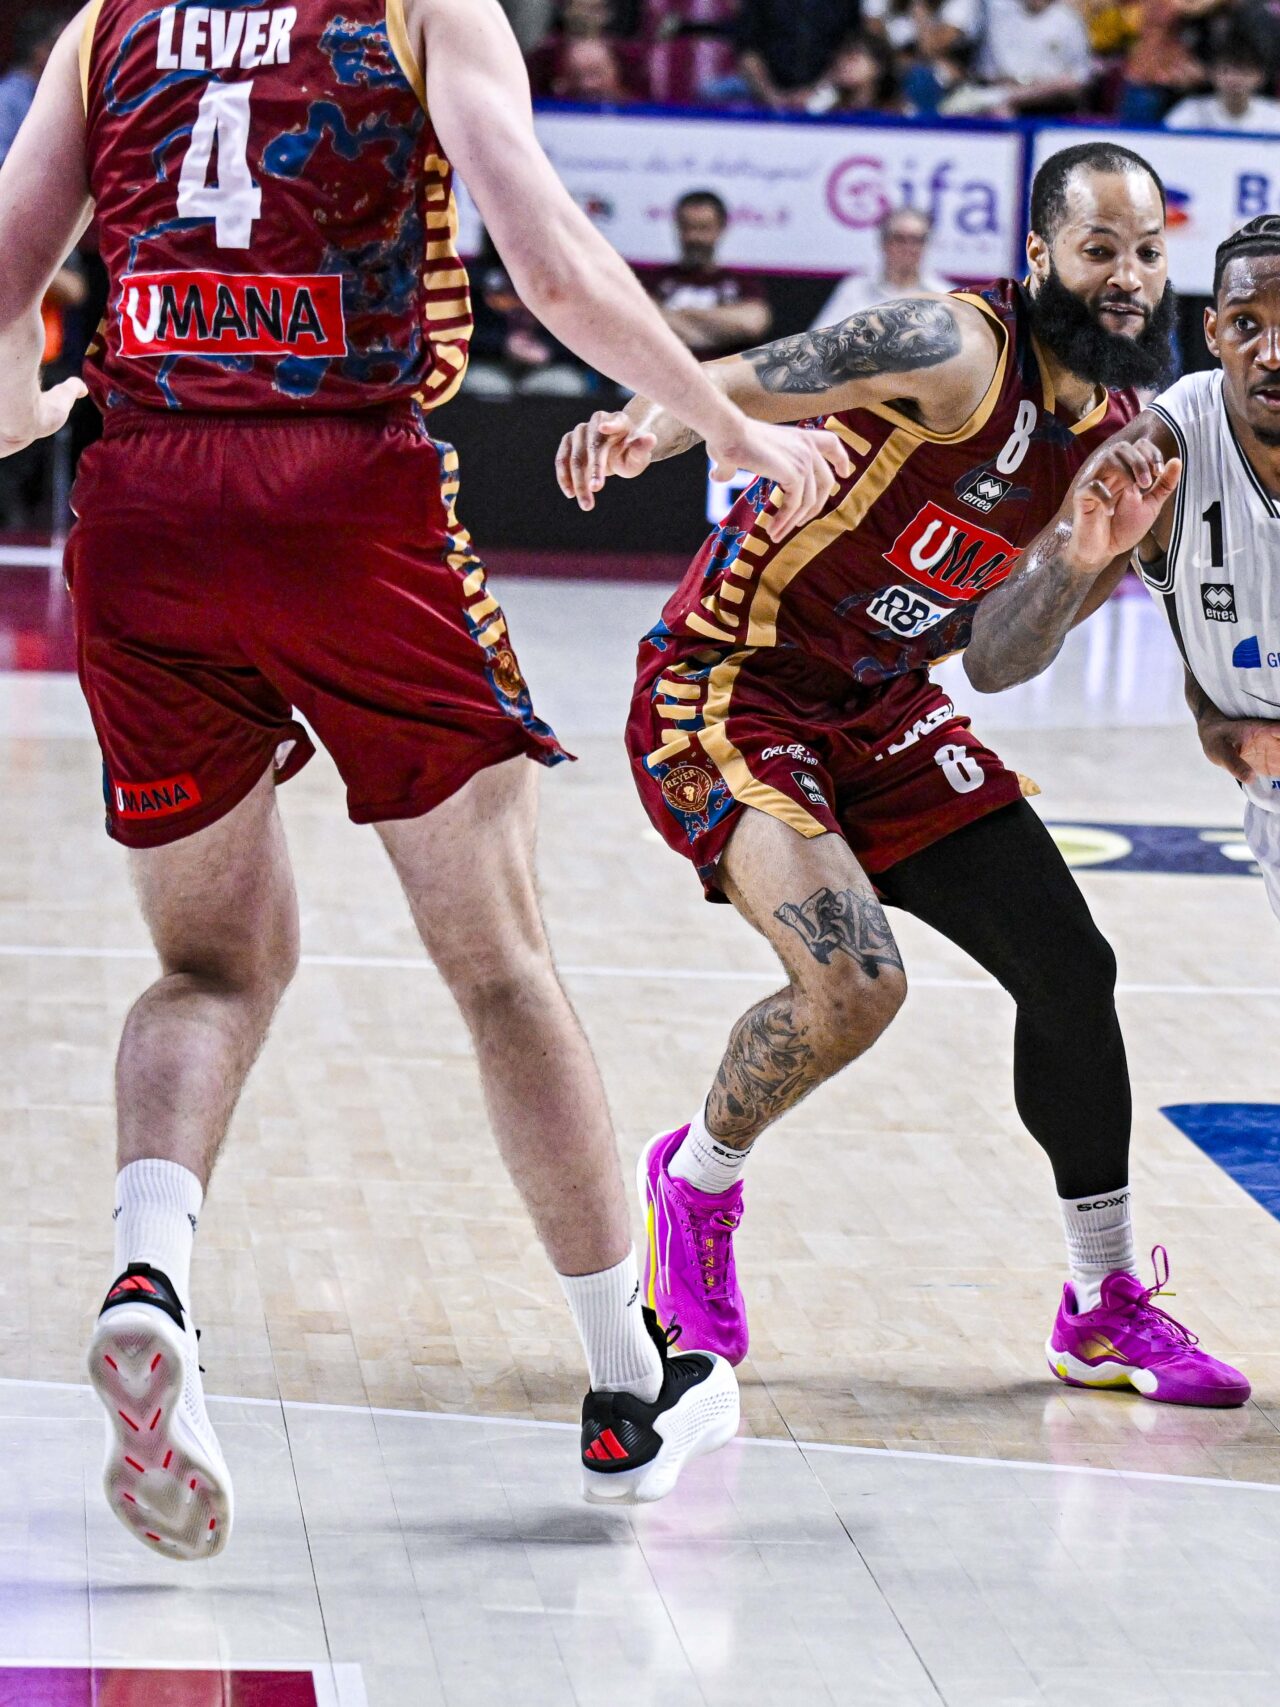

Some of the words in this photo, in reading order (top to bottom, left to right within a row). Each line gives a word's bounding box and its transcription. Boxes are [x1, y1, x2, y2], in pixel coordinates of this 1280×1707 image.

[156, 6, 297, 70] LEVER
[177, 80, 261, 249] 4
[826, 154, 999, 236] Gifa
[126, 284, 326, 344] UMANA
[996, 400, 1037, 474] 8
[910, 518, 1019, 590] UMA
[1202, 501, 1225, 567] 1
[115, 783, 190, 813] UMANA
[665, 769, 697, 789] REYER
[934, 744, 984, 793] 8
